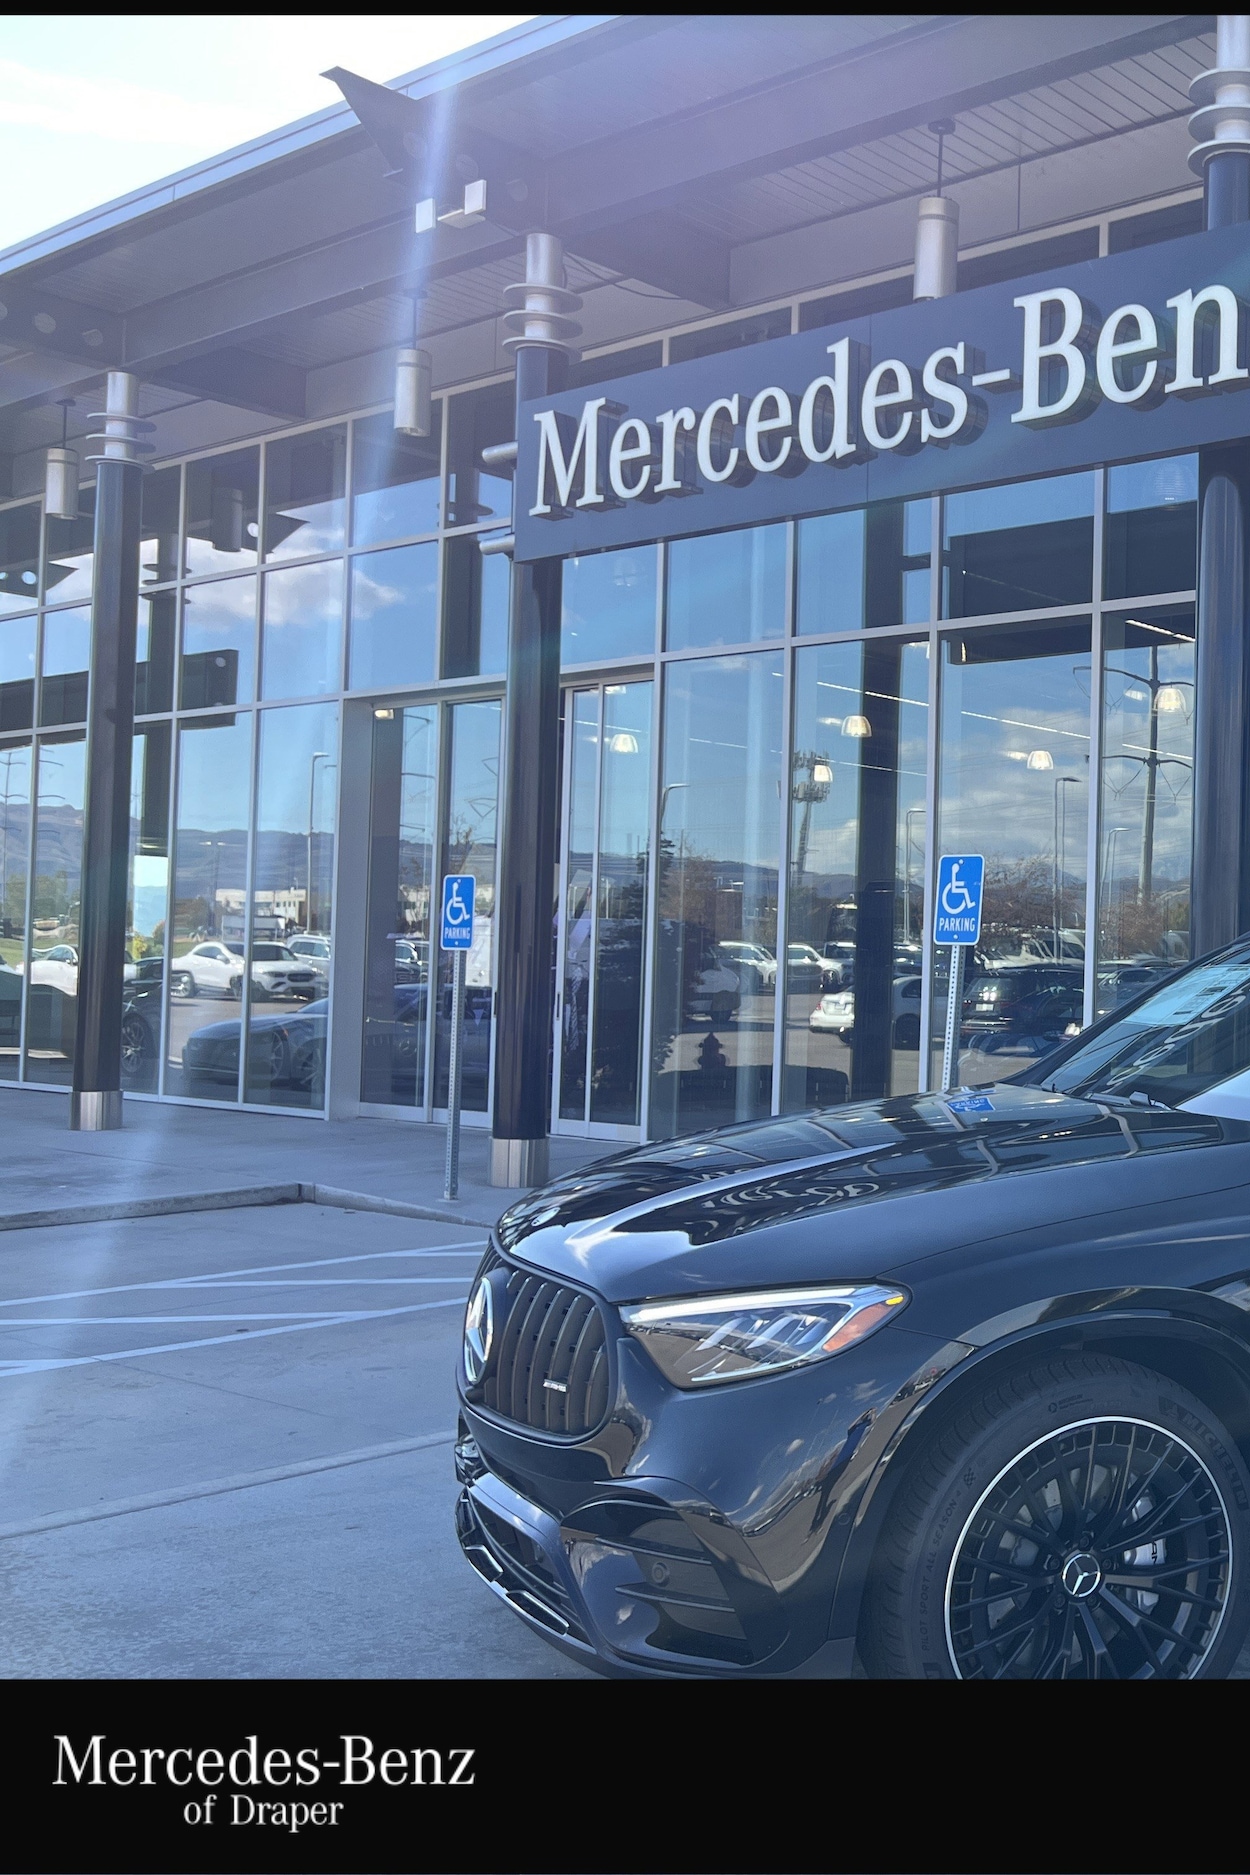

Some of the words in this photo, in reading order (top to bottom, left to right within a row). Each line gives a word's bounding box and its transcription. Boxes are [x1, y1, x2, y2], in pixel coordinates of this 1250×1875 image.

[444, 927, 471, 940] PARKING
[938, 917, 976, 932] PARKING
[1180, 1410, 1249, 1507] MICHELIN
[934, 1501, 958, 1546] SEASON
[928, 1549, 937, 1572] ALL
[920, 1578, 931, 1614] SPORT
[919, 1618, 930, 1651] PILOT
